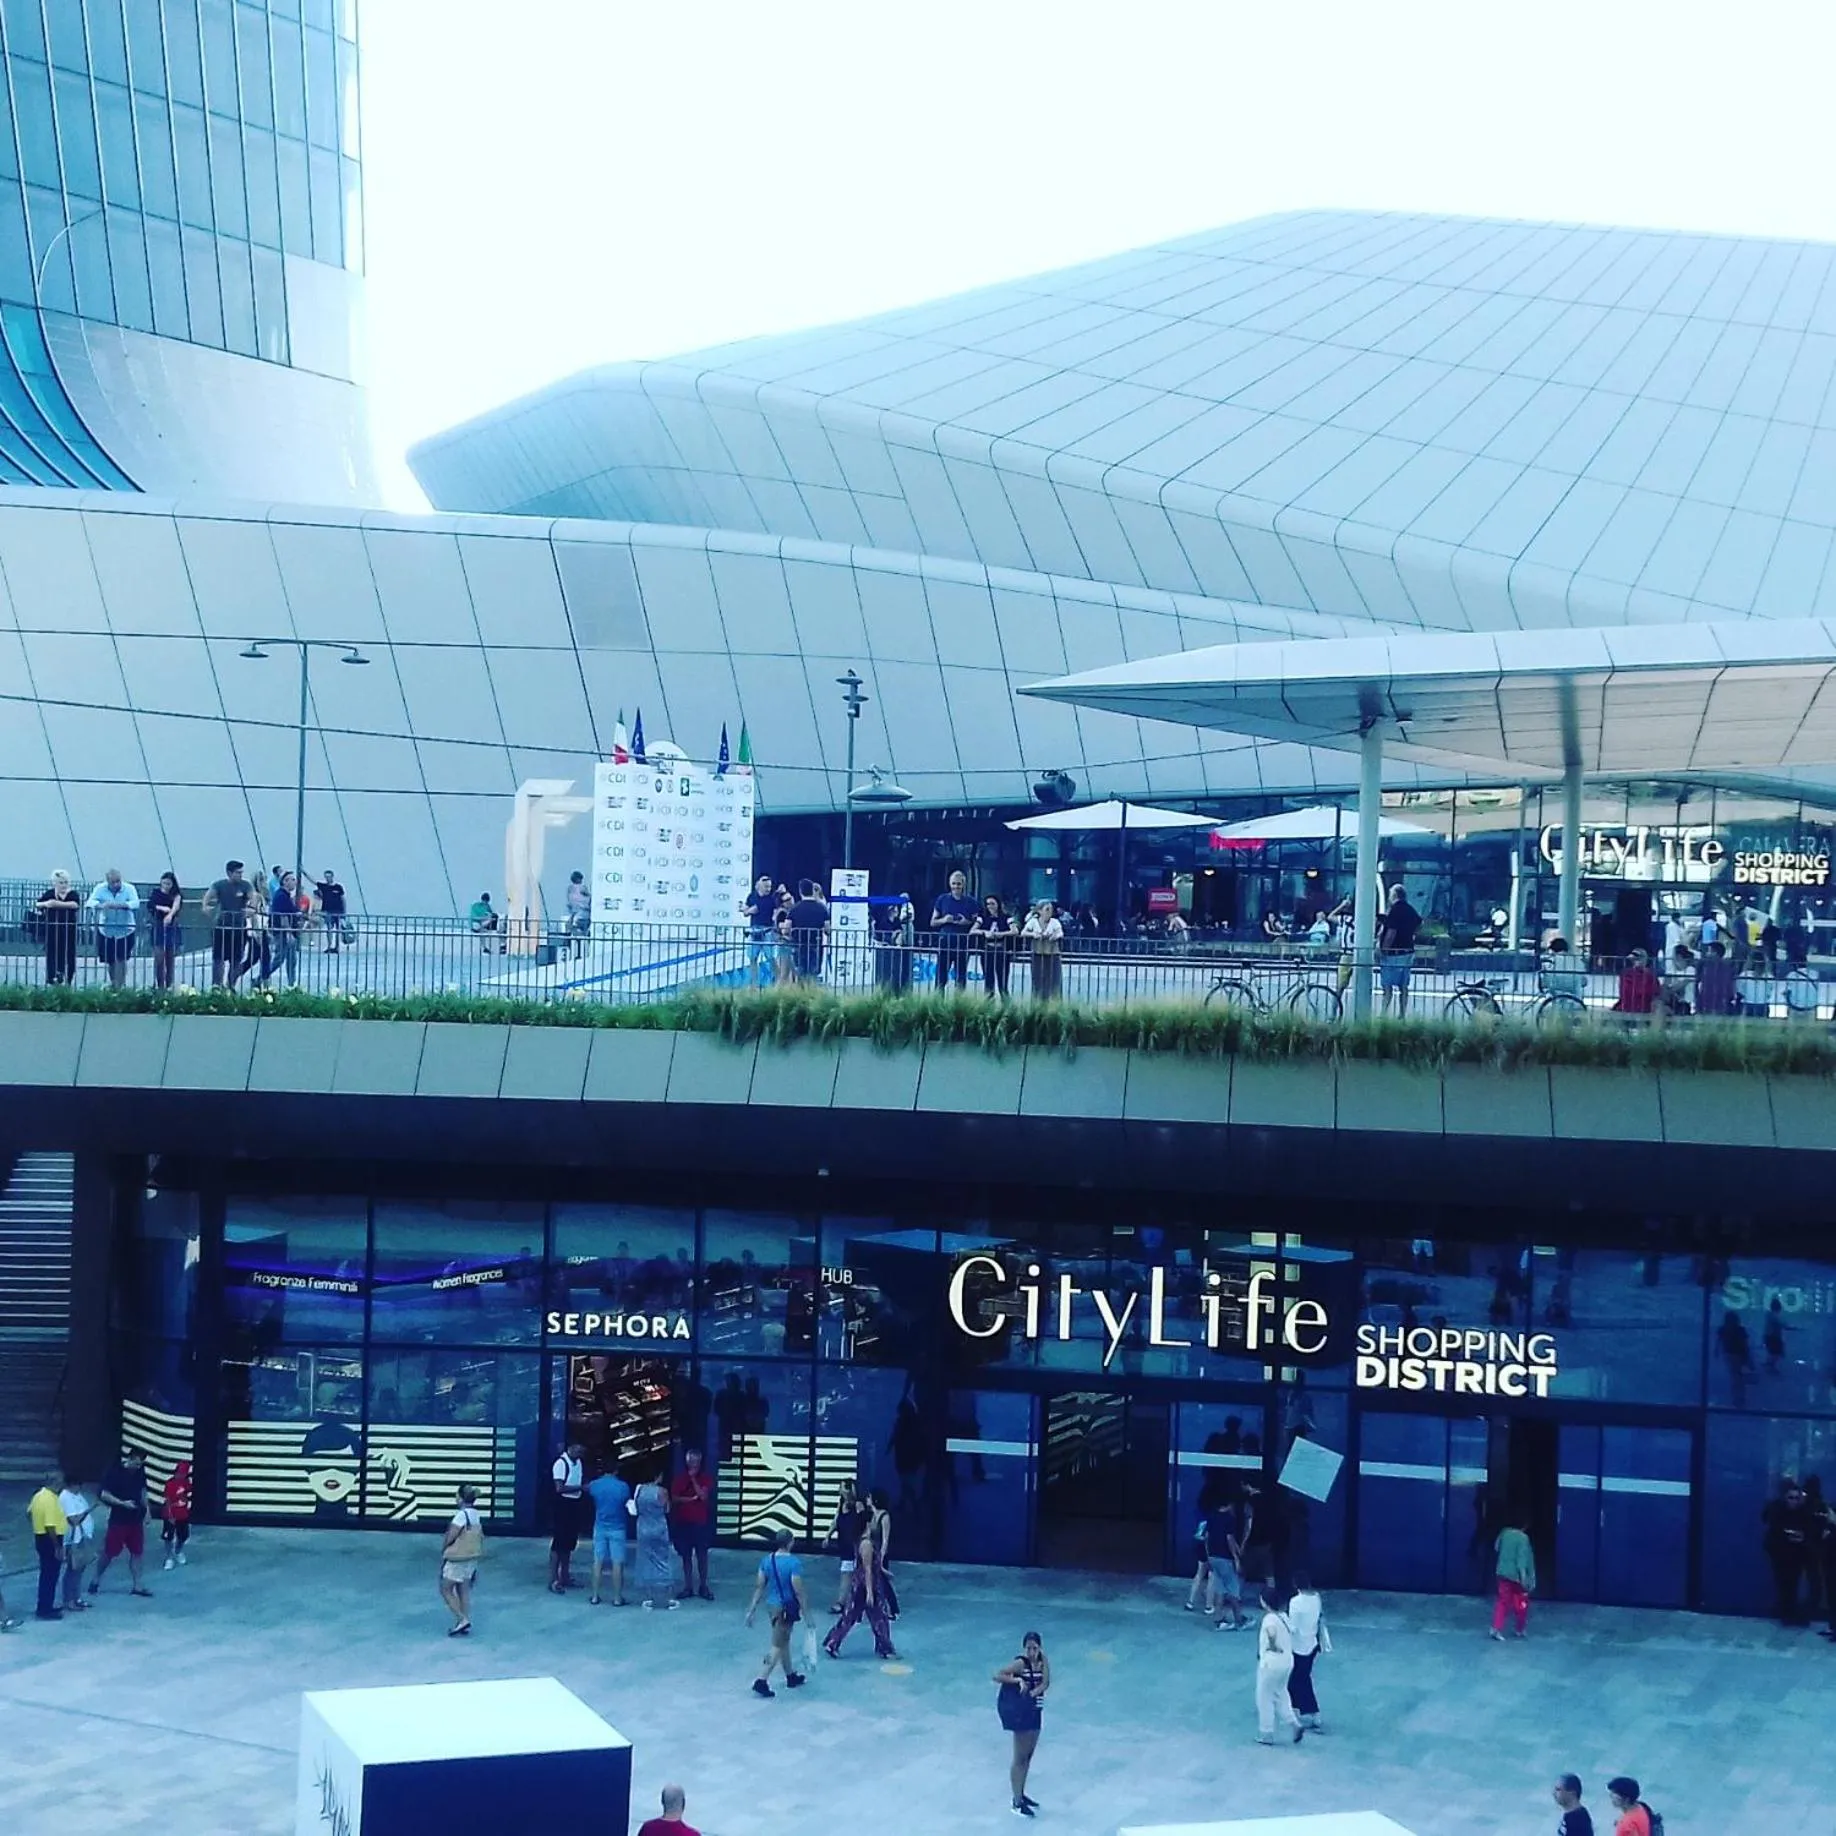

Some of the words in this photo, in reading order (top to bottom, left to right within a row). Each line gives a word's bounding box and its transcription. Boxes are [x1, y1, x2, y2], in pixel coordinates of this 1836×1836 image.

[1734, 851, 1829, 868] SHOPPING
[1734, 867, 1829, 885] DISTRICT
[821, 1267, 853, 1285] HUB
[546, 1310, 691, 1340] SEPHORA
[947, 1255, 1329, 1367] CityLife
[1355, 1324, 1557, 1365] SHOPPING
[1355, 1356, 1557, 1399] DISTRICT
